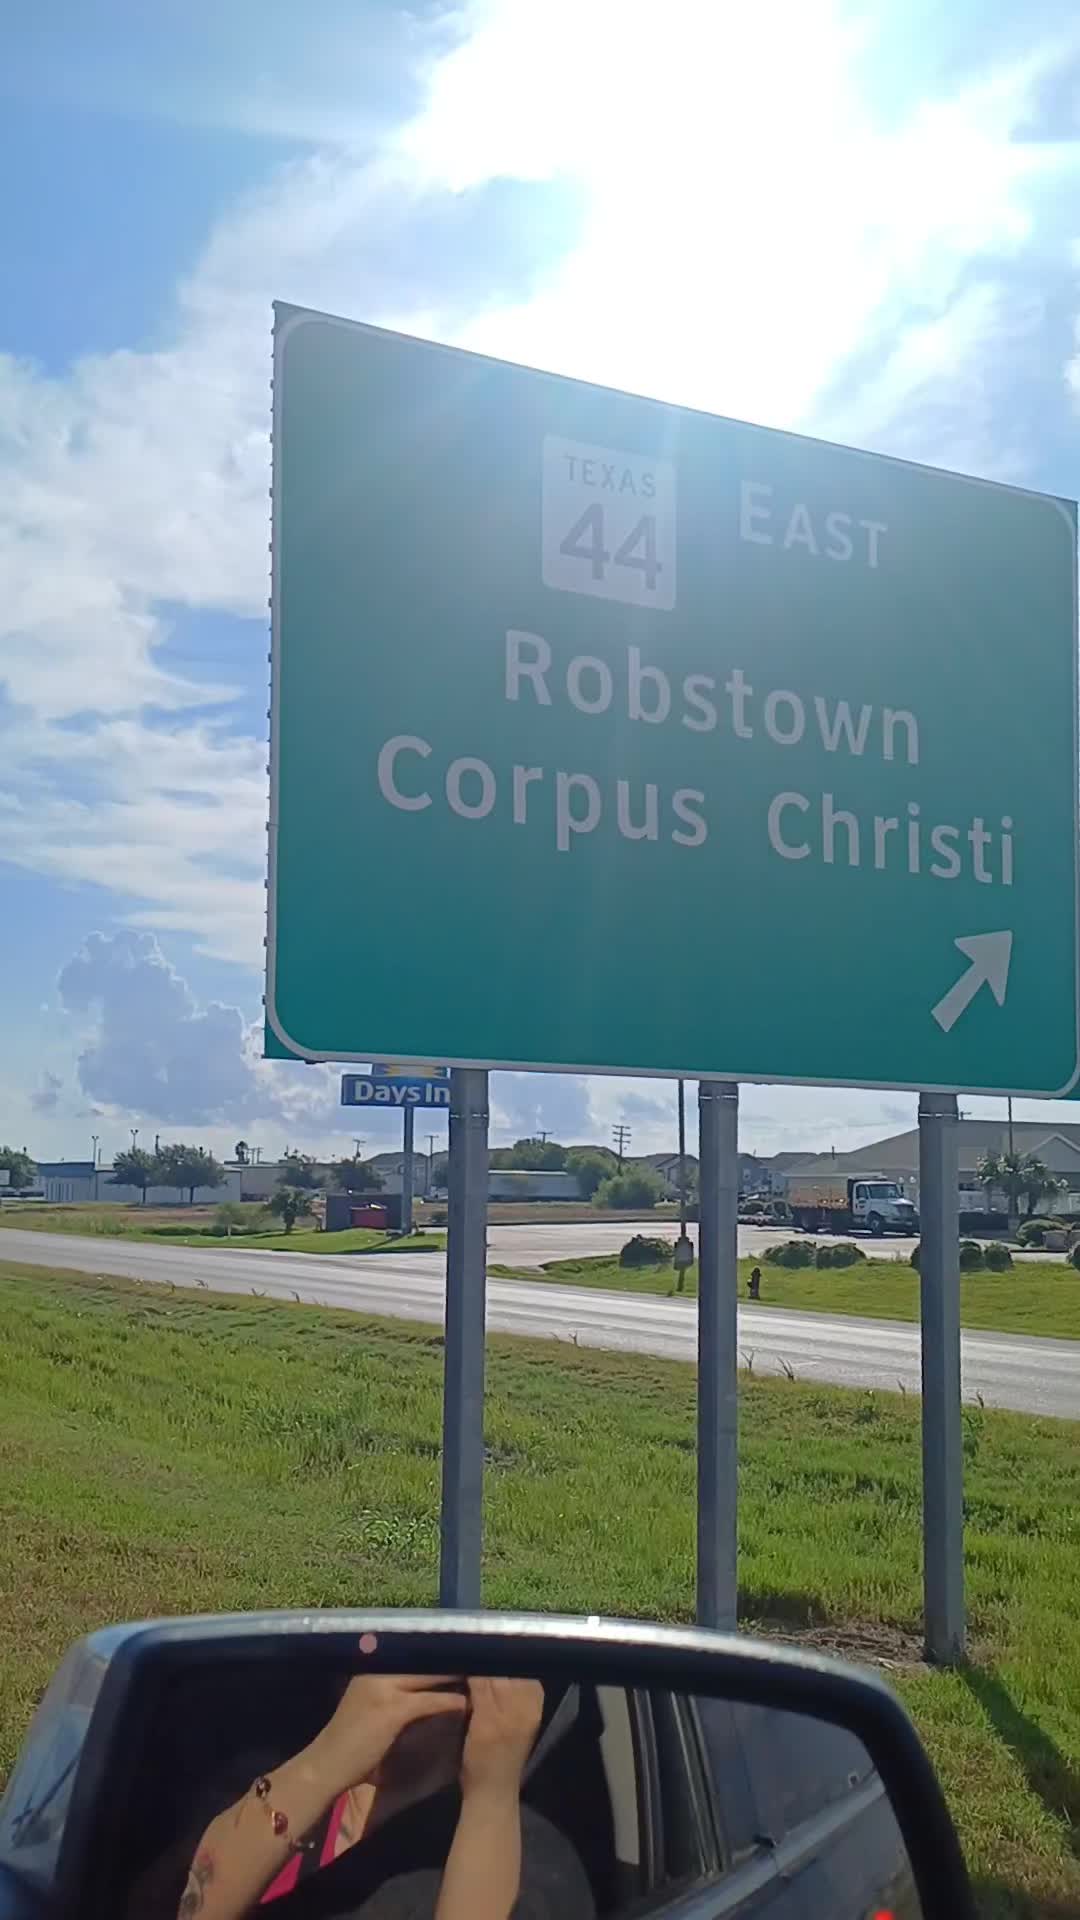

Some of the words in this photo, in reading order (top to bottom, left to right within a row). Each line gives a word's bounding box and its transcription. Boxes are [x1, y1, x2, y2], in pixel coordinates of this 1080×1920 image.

[564, 453, 657, 498] TEXAS
[559, 502, 663, 590] 44
[739, 479, 888, 569] EAST
[505, 629, 919, 765] Robstown
[376, 735, 708, 852] Corpus
[767, 791, 1014, 885] Christi
[354, 1080, 421, 1104] Days
[425, 1082, 449, 1103] In
